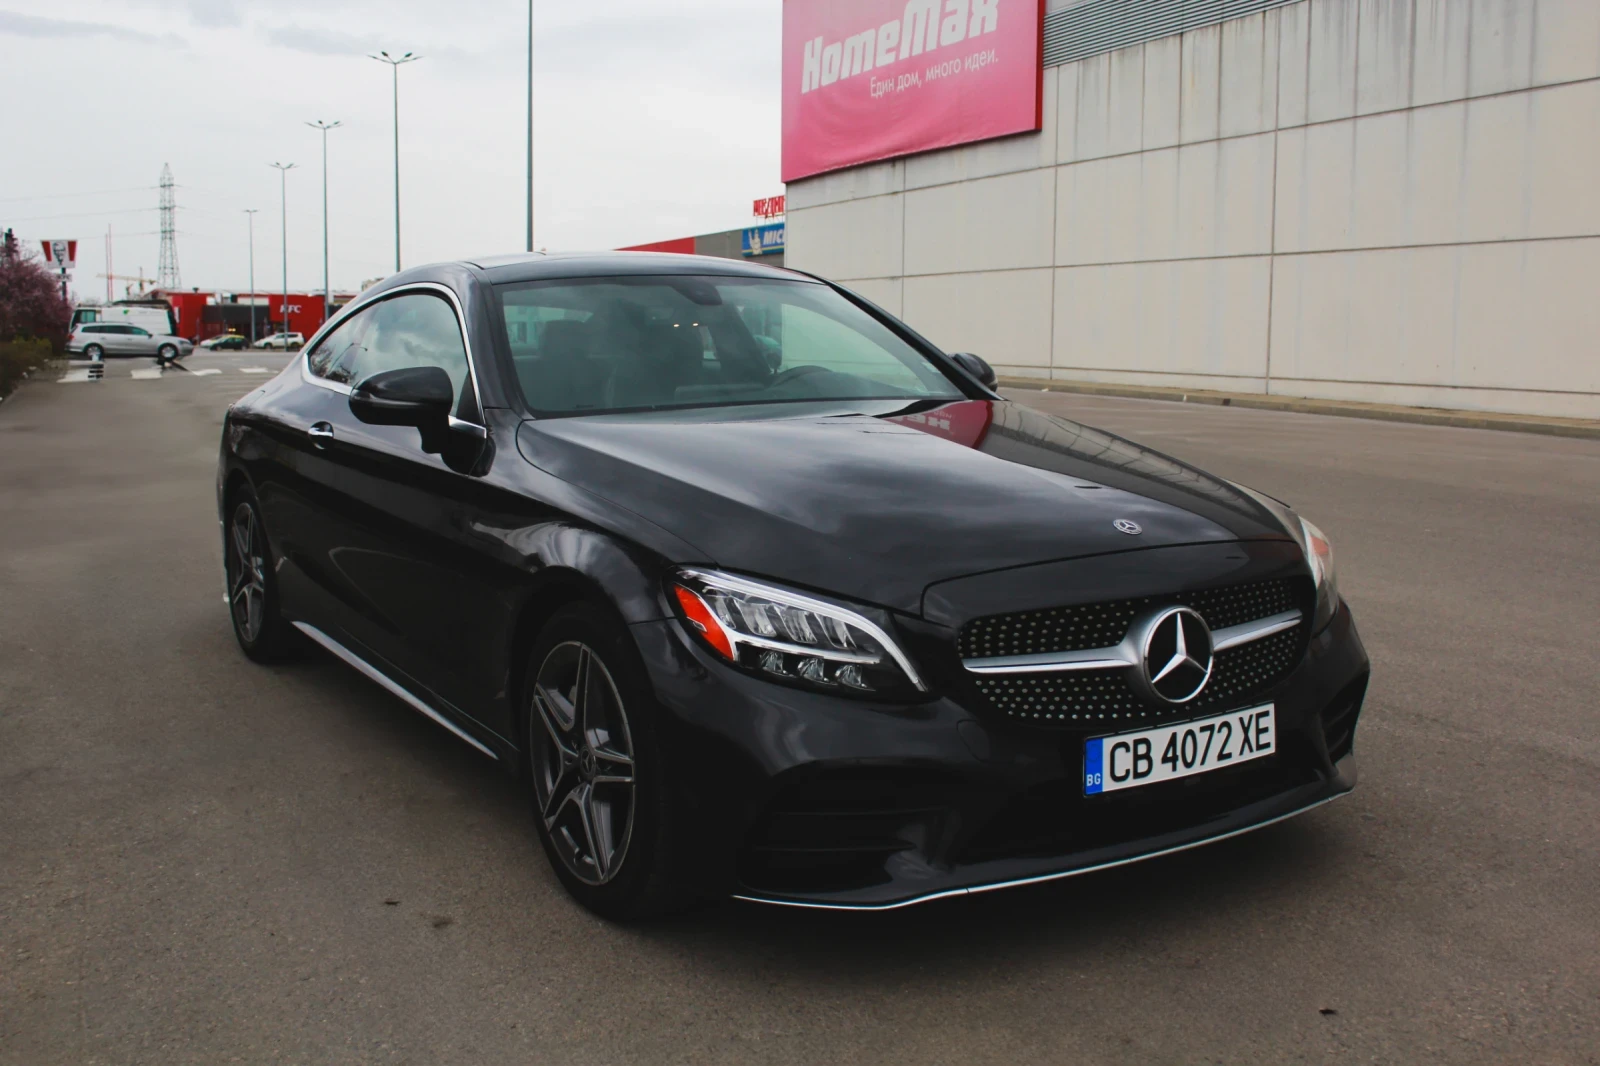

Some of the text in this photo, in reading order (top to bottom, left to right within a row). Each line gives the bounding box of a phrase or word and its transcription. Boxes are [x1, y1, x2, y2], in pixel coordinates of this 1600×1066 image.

[870, 48, 999, 99] Един дом, много идеи.
[1109, 710, 1271, 784] CB 4072 XE
[1086, 773, 1101, 787] BG
